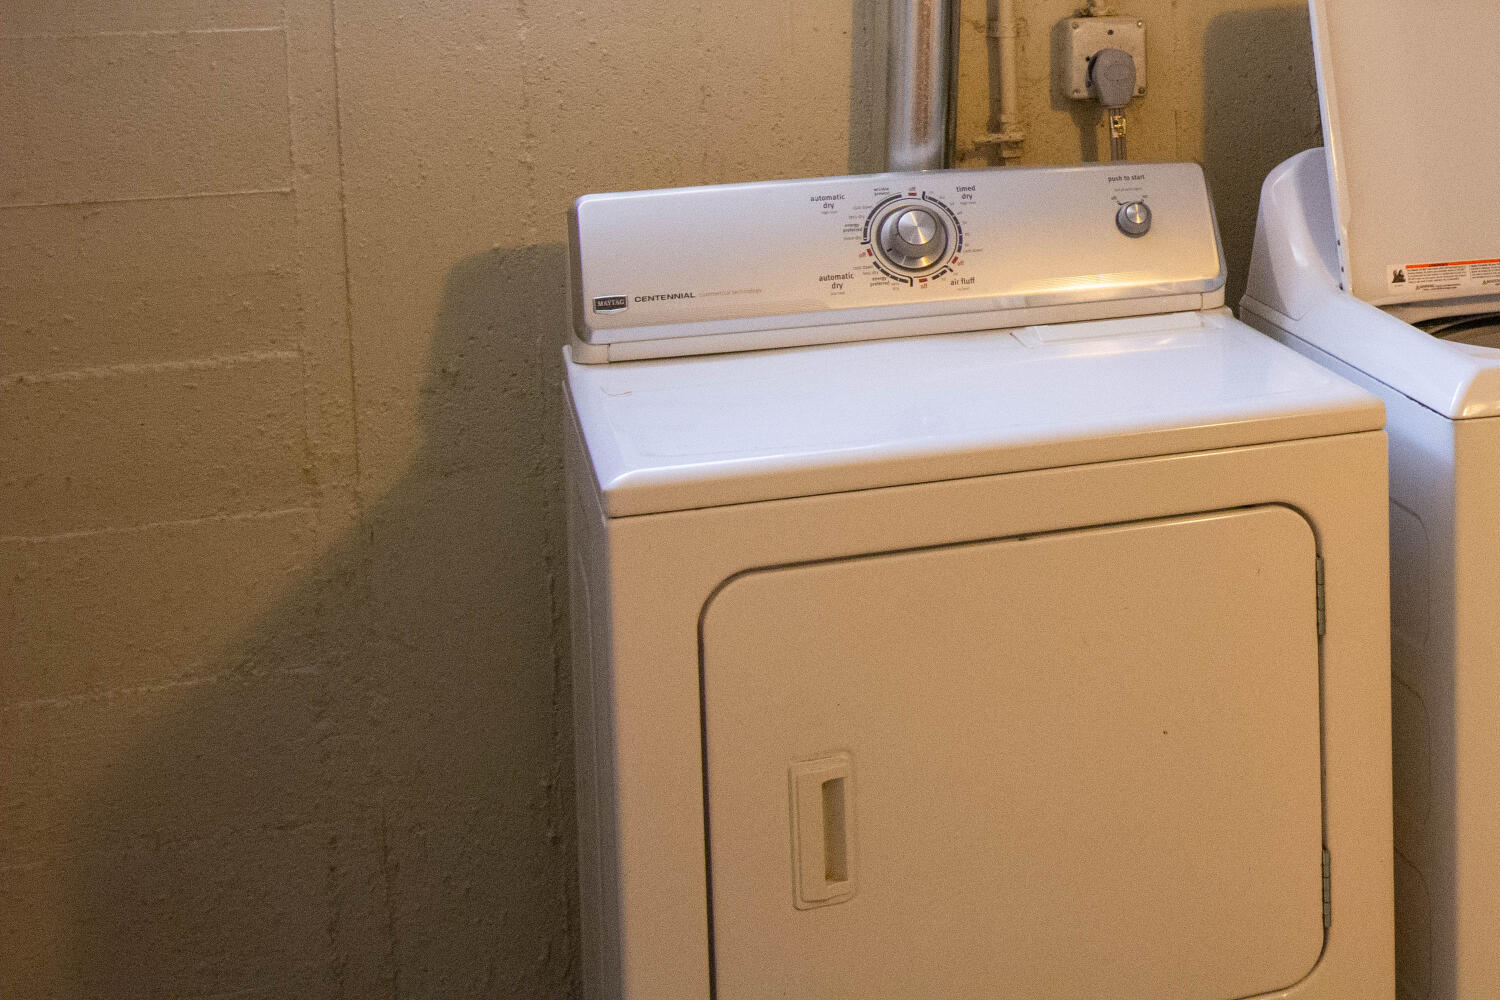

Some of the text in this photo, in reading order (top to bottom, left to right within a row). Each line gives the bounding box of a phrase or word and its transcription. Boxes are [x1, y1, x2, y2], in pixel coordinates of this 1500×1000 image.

[1107, 175, 1122, 183] push
[956, 185, 976, 193] timed
[810, 193, 846, 203] automatic
[823, 202, 835, 210] dry
[818, 272, 855, 282] automatic
[950, 278, 959, 286] air
[961, 276, 976, 285] fluff
[831, 282, 843, 290] dry
[596, 297, 627, 308] MAYTAG
[634, 291, 696, 304] CENTENNIAL
